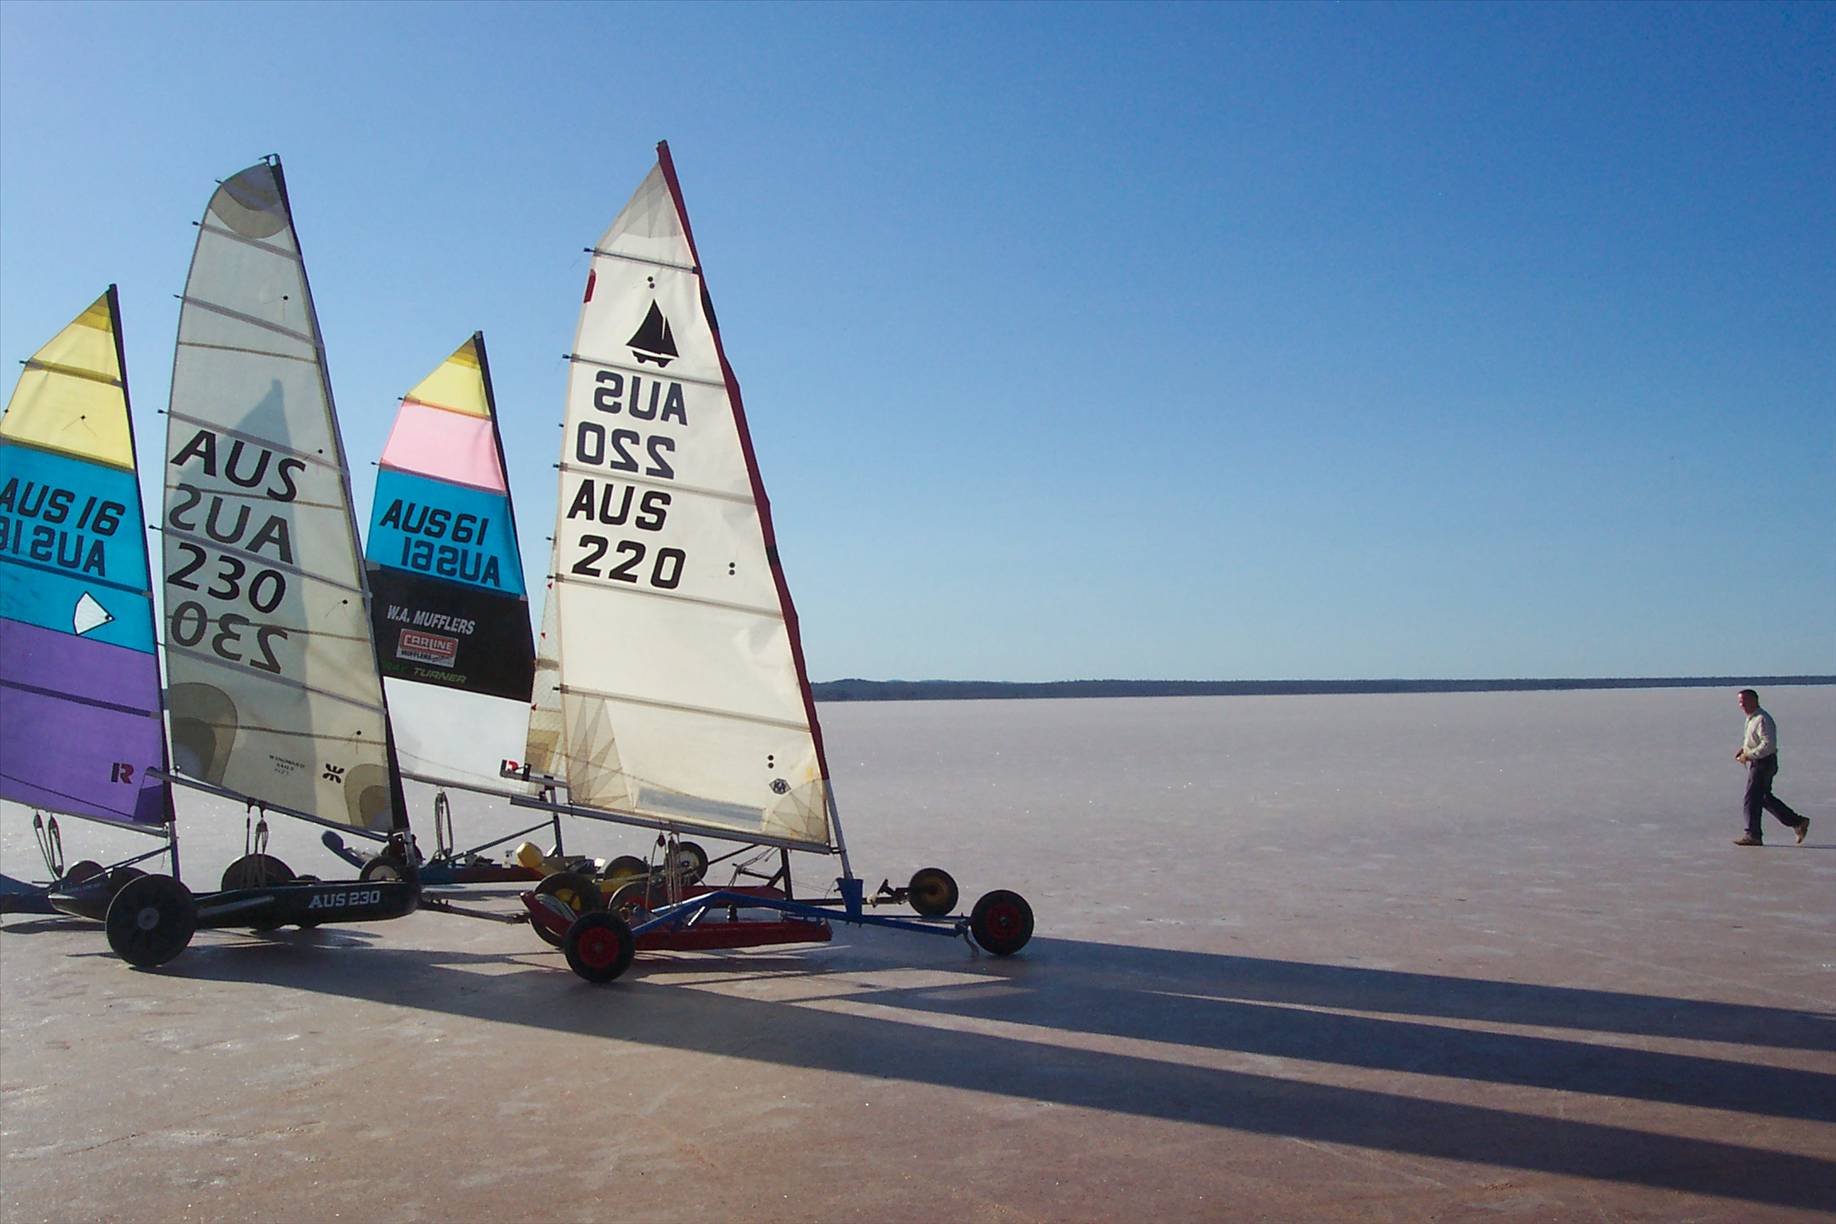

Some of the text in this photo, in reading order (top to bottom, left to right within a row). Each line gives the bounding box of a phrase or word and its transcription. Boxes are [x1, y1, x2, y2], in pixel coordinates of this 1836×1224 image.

[169, 429, 306, 502] AUS
[0, 477, 126, 537] AUS 16
[378, 498, 489, 546] AUS 61
[566, 479, 672, 532] AUS
[167, 542, 286, 614] 230
[571, 534, 687, 590] 220
[387, 604, 476, 635] W.A. MUFFLERS
[414, 667, 467, 684] TURNER
[308, 890, 381, 909] AUS 230
